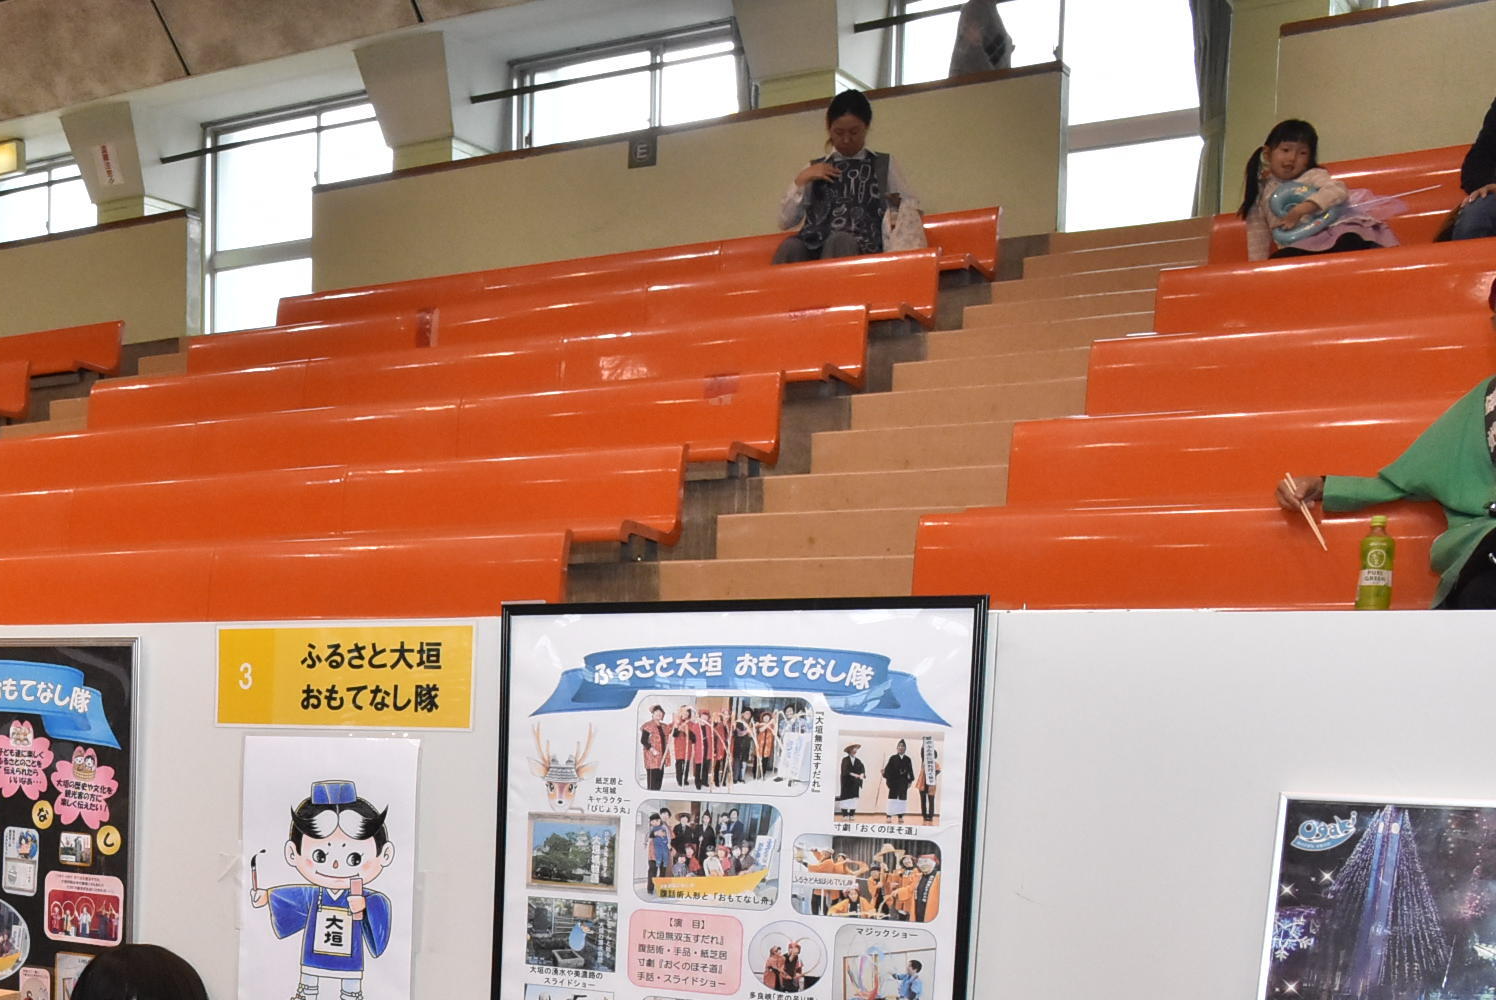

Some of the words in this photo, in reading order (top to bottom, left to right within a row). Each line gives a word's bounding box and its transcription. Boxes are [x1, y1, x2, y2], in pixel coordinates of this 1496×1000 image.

[636, 144, 648, 159] E
[300, 641, 442, 670] ふるさと大垣
[238, 662, 253, 690] 3
[593, 651, 723, 686] ふるさと大垣
[734, 652, 875, 690] おもてなし隊
[300, 684, 440, 713] おもてなし隊
[588, 795, 631, 804] キャラクター
[834, 823, 919, 837] 寸劇「おくのほそ道」
[1297, 810, 1358, 841] Ogaki
[323, 914, 343, 947] 大垣
[642, 929, 725, 945] 『大垣無双玉すだれ』
[855, 928, 919, 939] マジックショー
[544, 978, 596, 988] スライドショー
[636, 971, 726, 988] 手話・スライドショー
